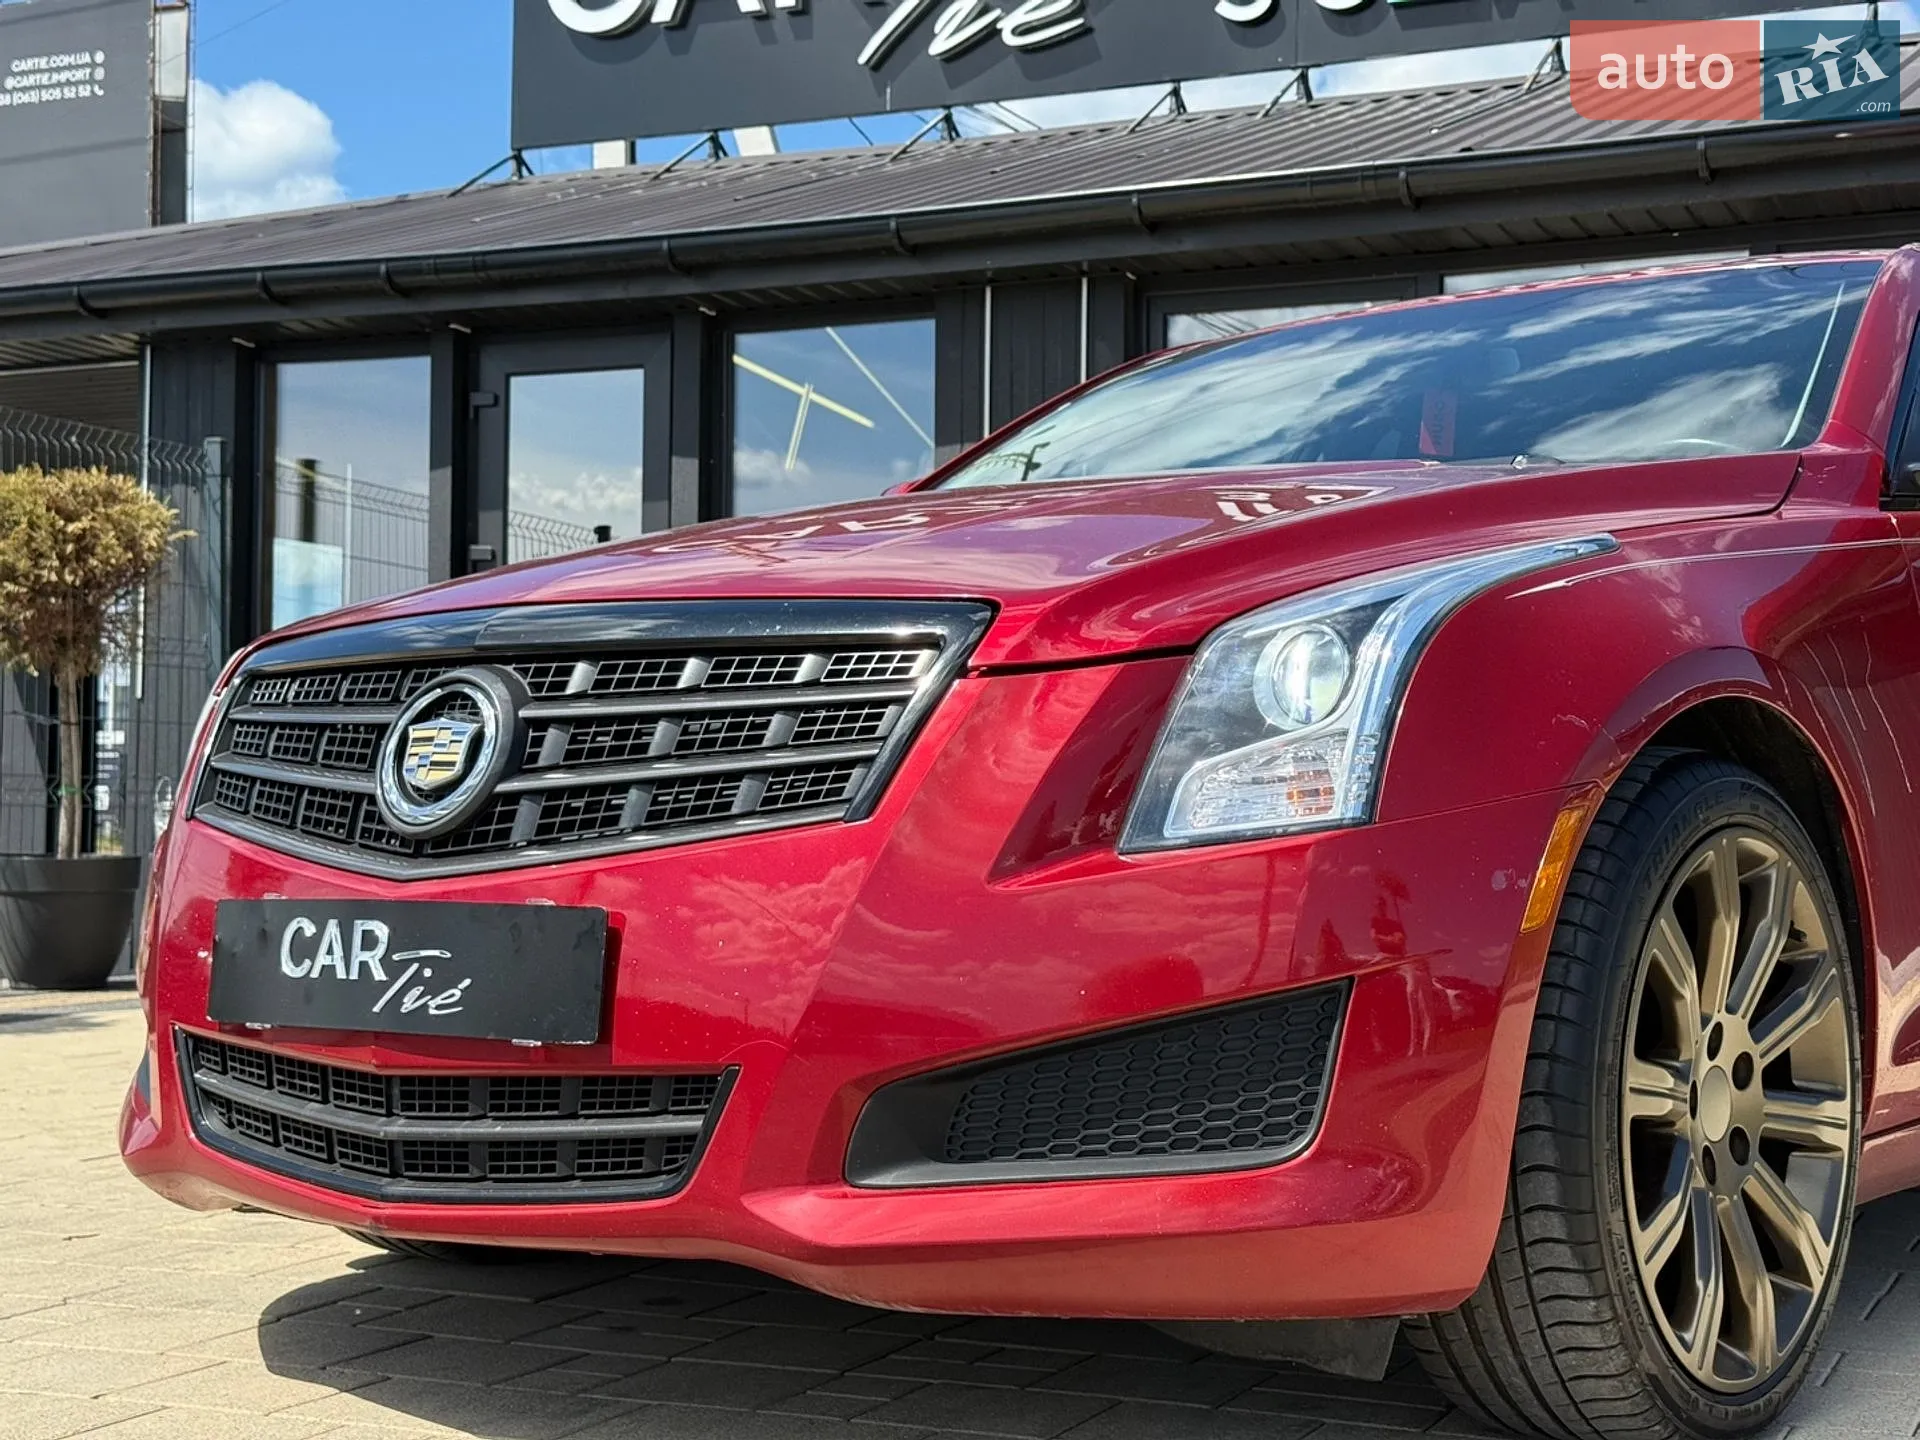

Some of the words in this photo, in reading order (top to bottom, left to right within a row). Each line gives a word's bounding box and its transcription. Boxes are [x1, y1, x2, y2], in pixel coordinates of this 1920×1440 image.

[10, 51, 92, 73] CARTIE.COM.UA
[62, 85, 77, 99] 52
[77, 83, 92, 97] 52
[280, 916, 390, 981] CAR
[372, 949, 473, 1015] Tié
